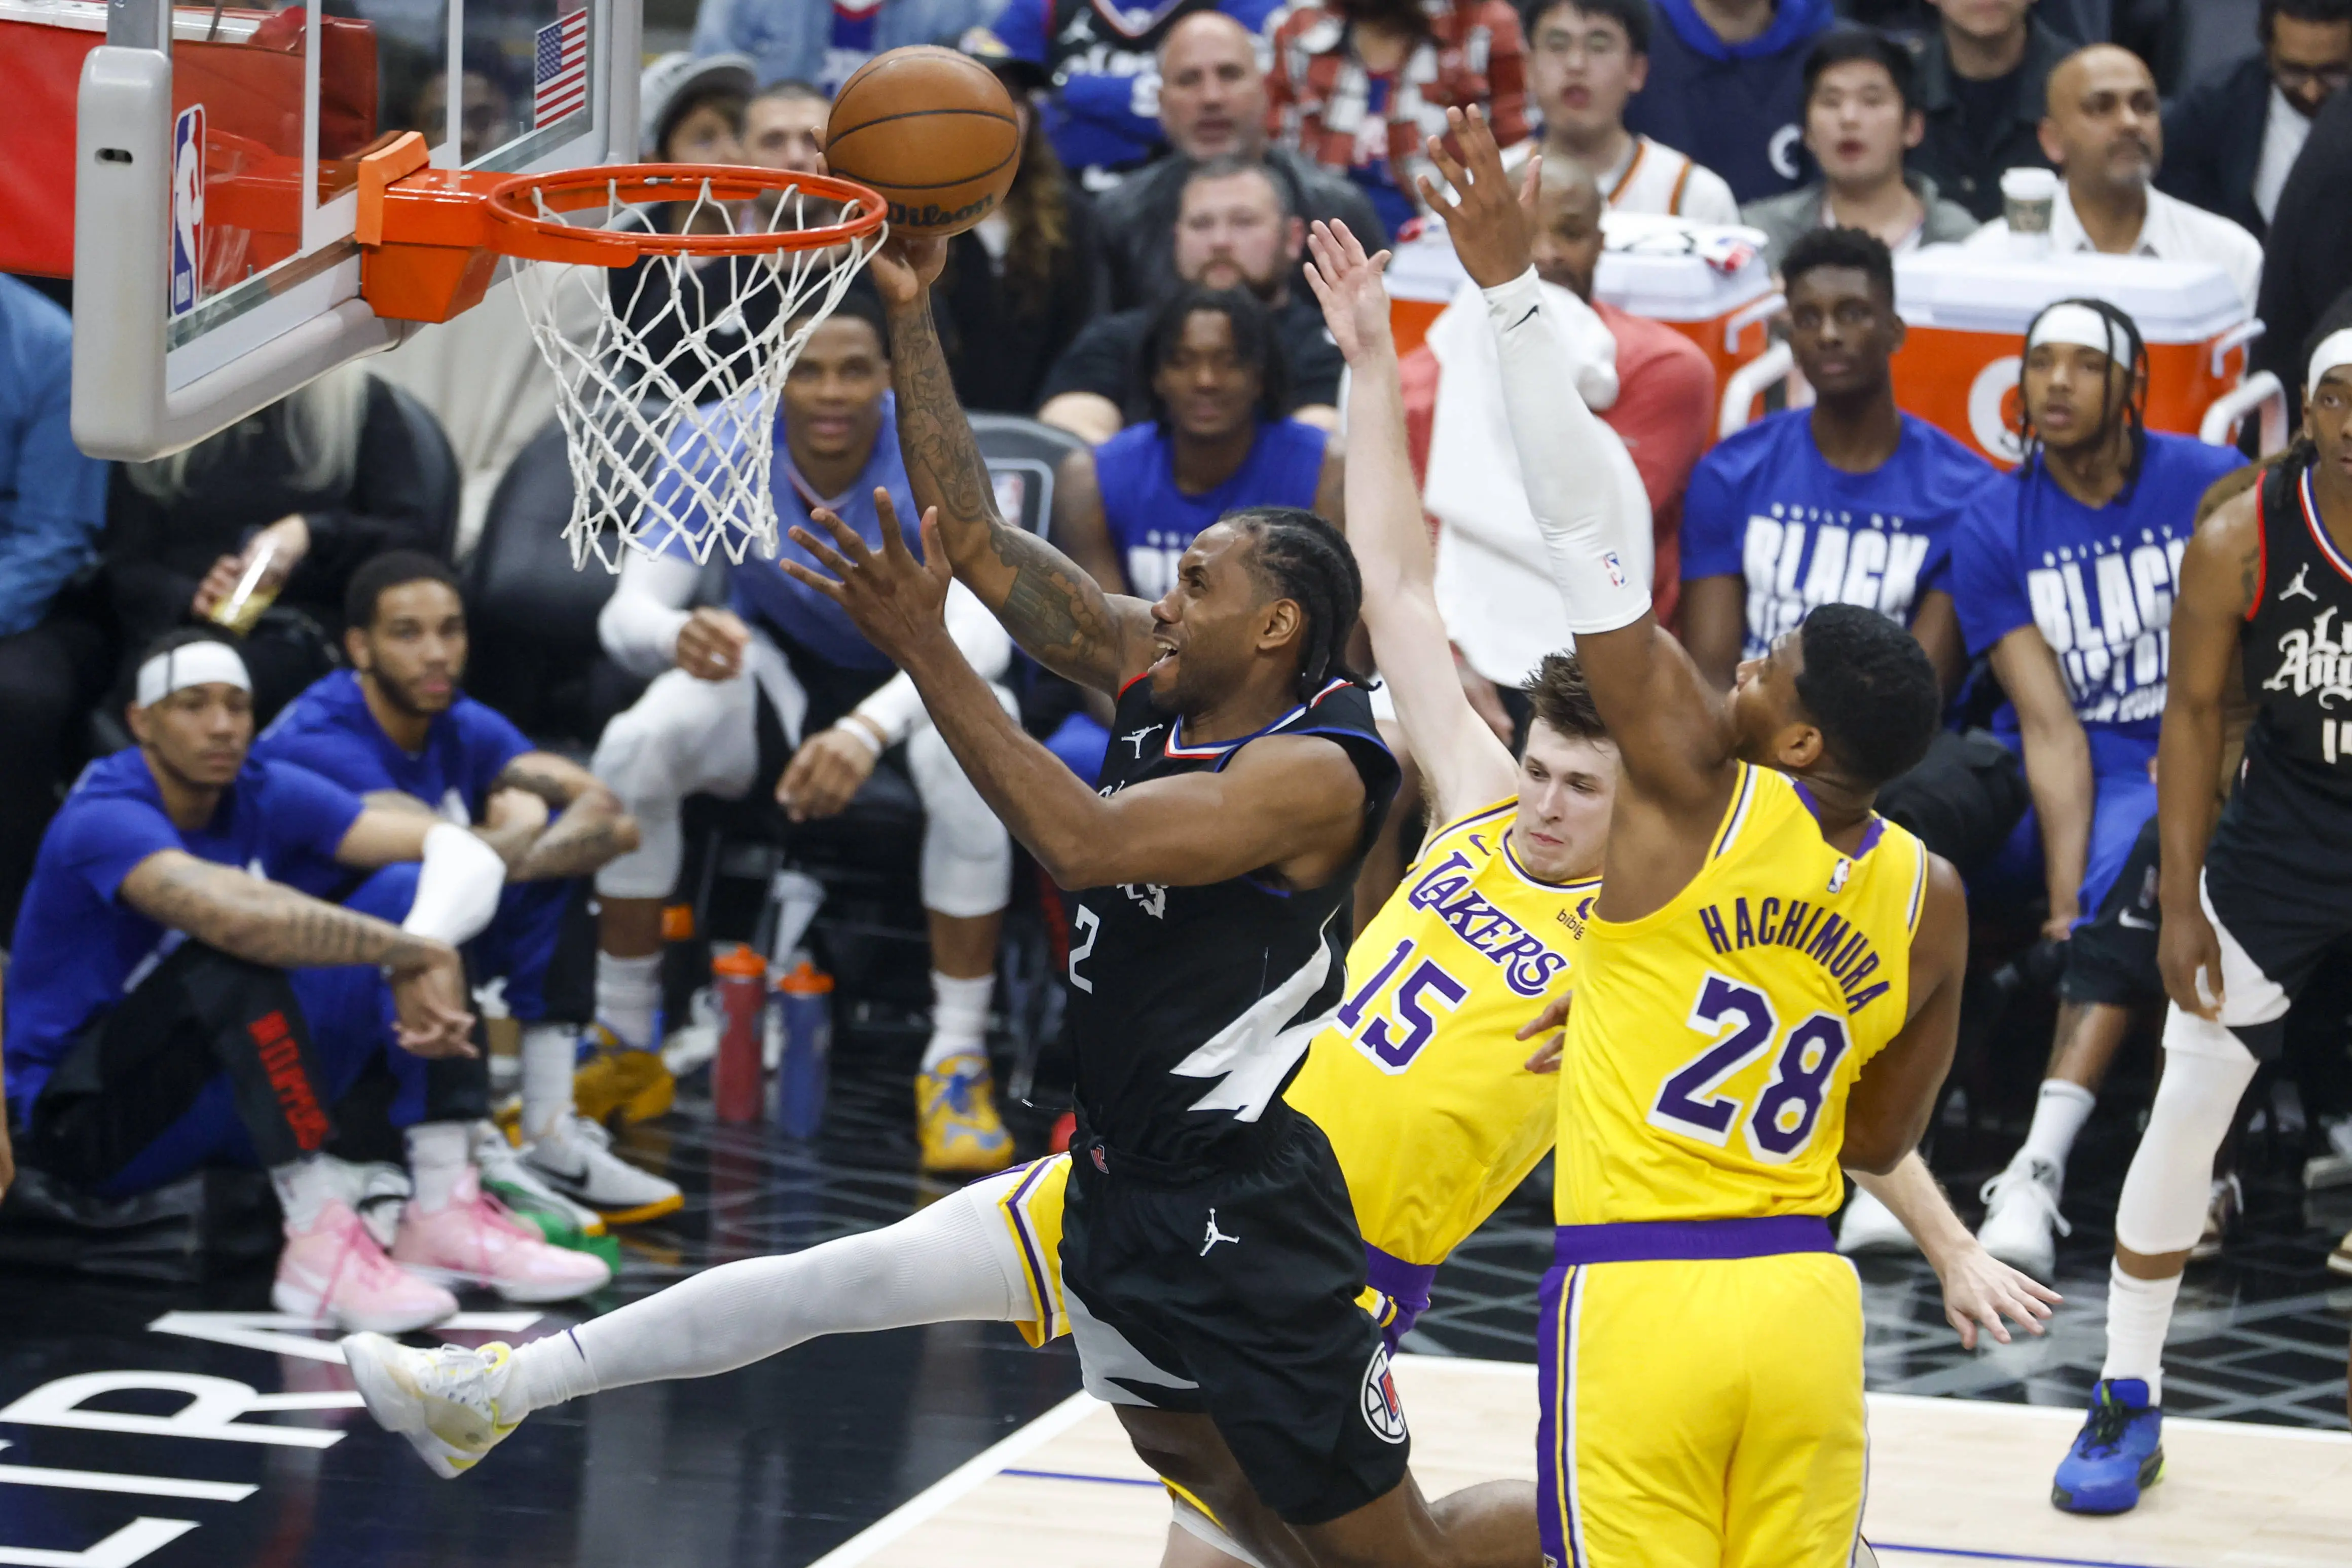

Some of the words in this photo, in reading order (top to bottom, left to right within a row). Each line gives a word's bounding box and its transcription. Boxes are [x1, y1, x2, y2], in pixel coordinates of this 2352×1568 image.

[1069, 904, 1100, 994] 2
[1408, 849, 1570, 999] LAKERS
[1698, 897, 1890, 1015] HACHIMURA
[1333, 937, 1470, 1076] 15
[1646, 969, 1852, 1165] 28
